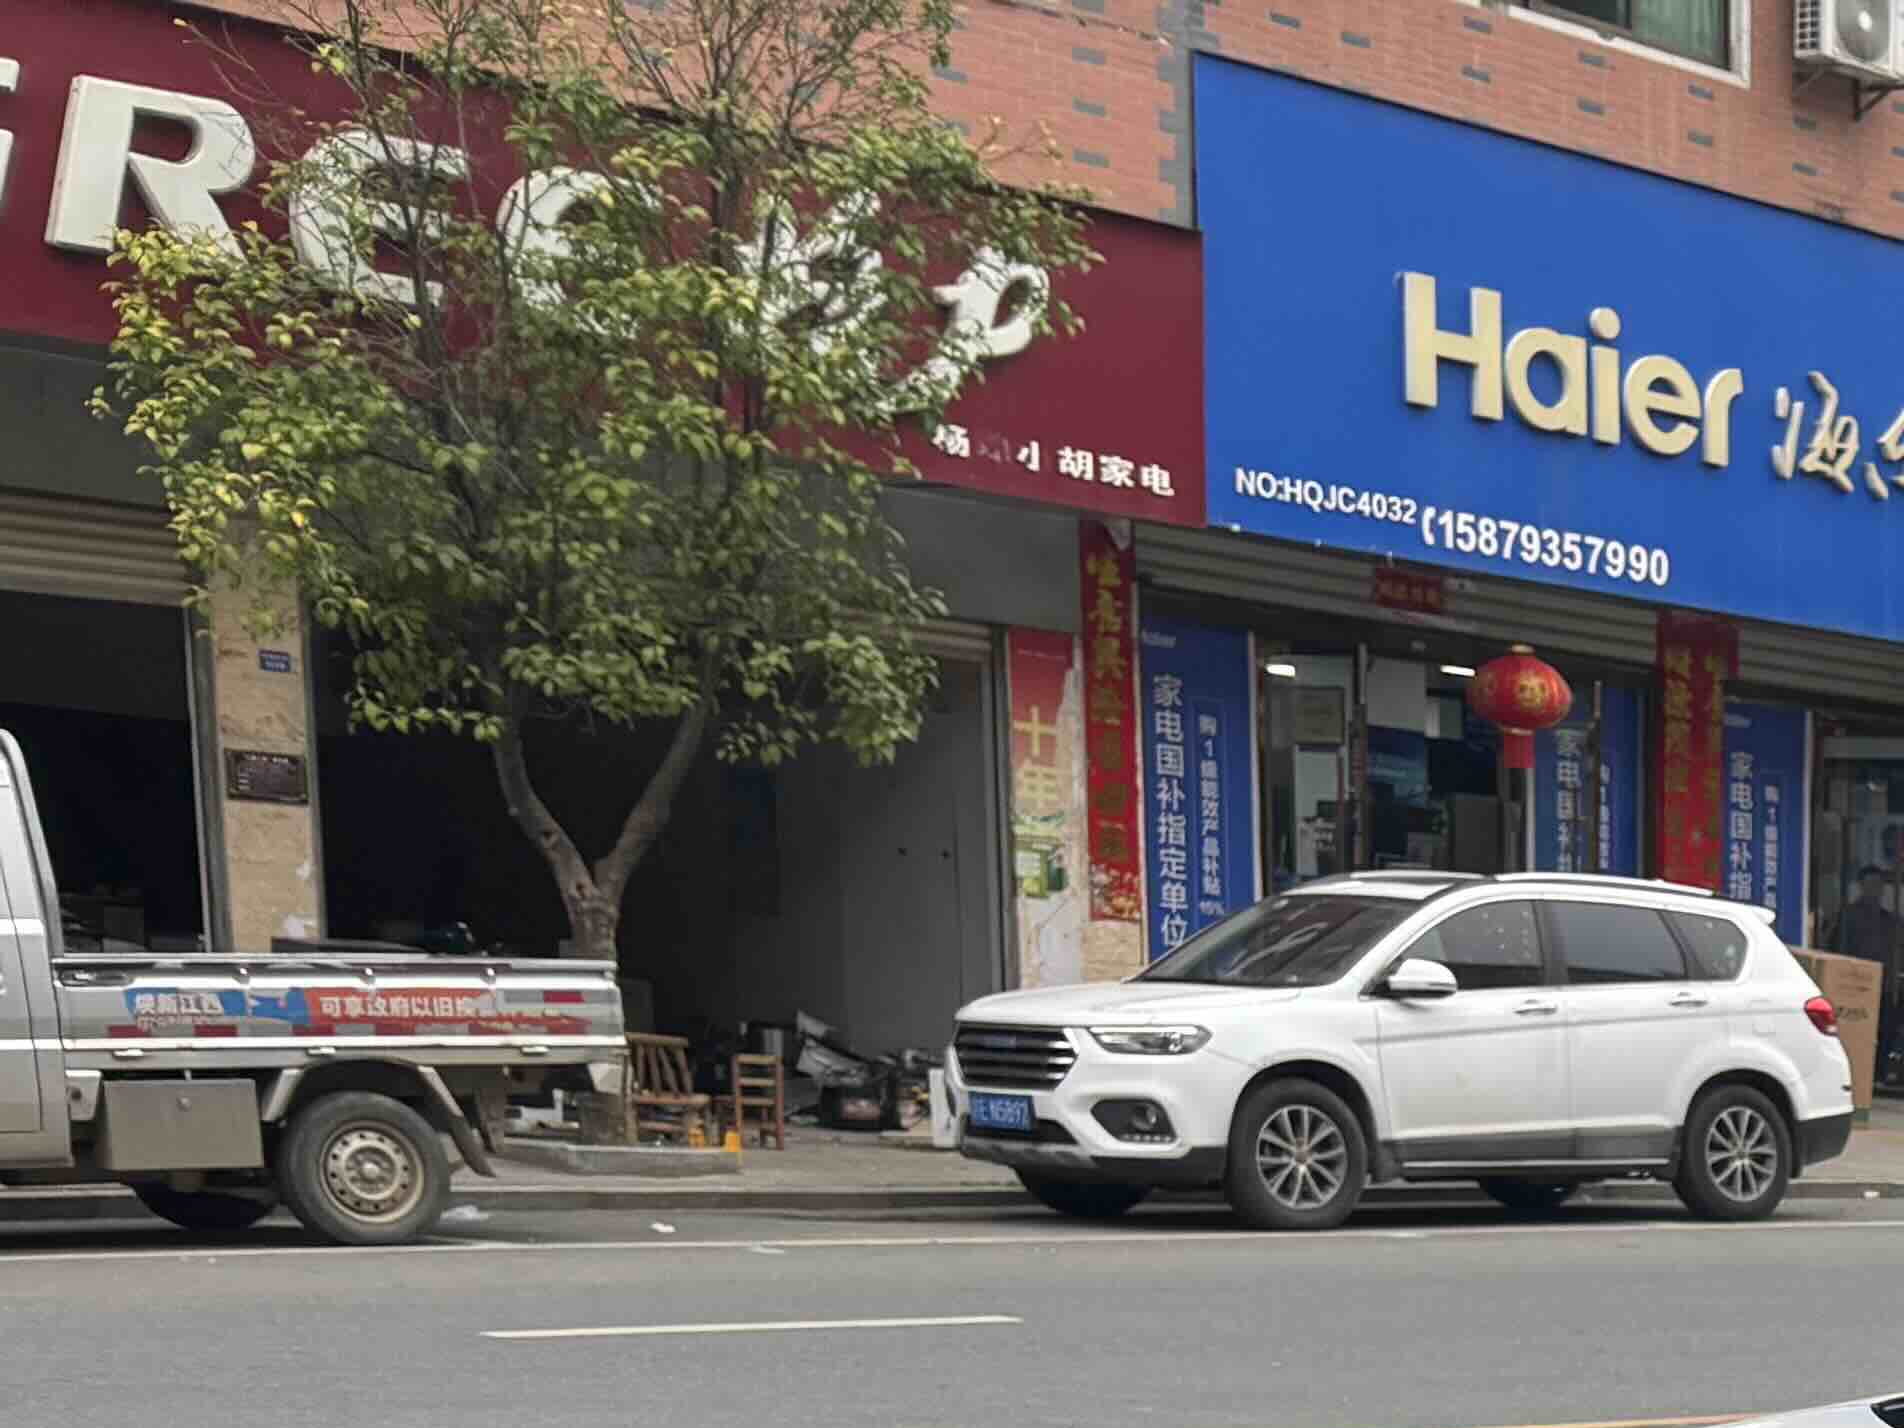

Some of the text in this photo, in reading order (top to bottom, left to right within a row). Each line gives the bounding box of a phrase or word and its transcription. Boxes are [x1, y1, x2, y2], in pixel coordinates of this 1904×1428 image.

[1401, 270, 1744, 468] Haier
[1438, 508, 1670, 587] 15879357990
[1153, 674, 1188, 946] 家电国补指定单位
